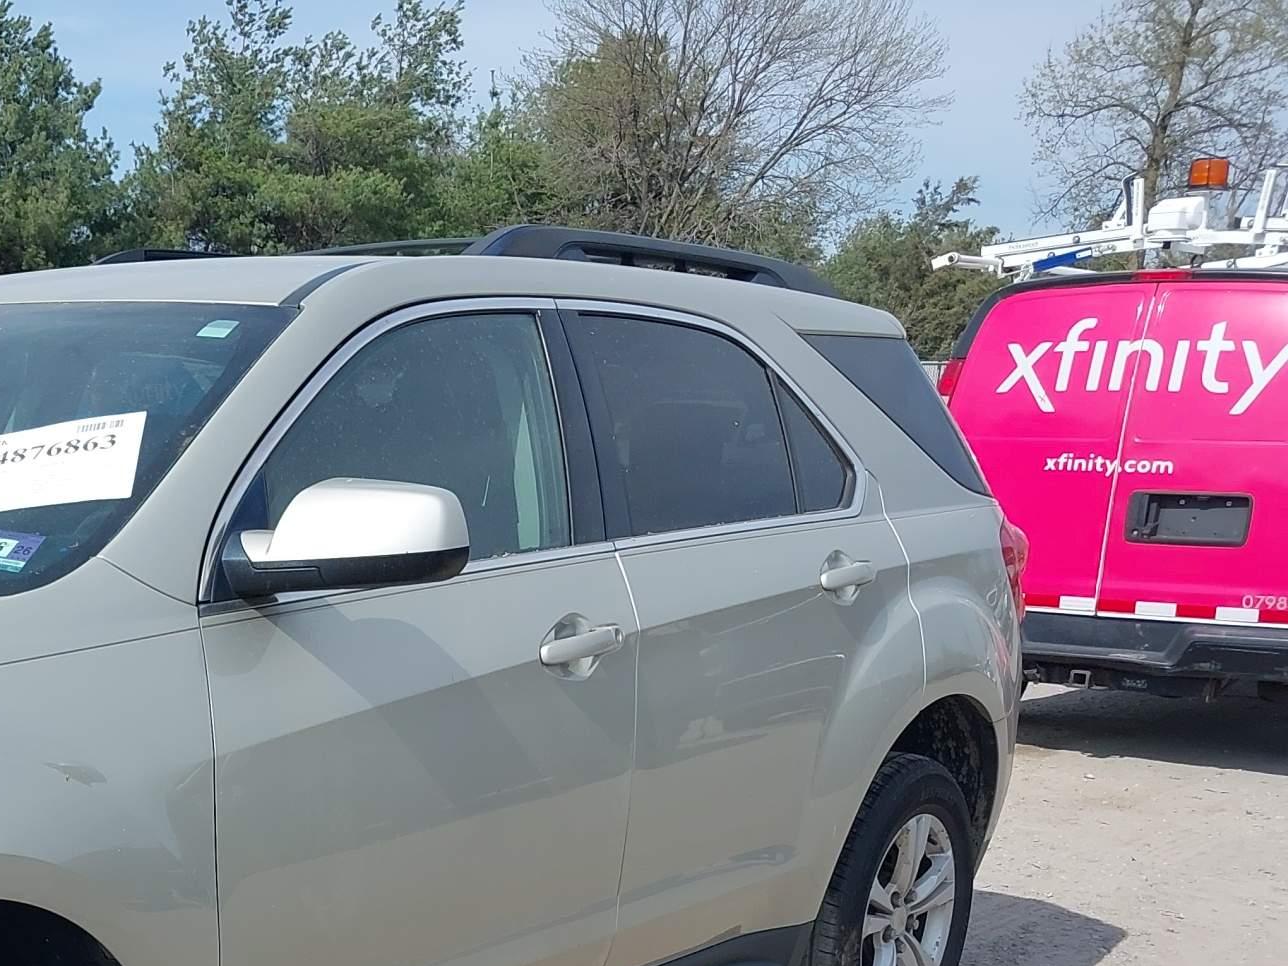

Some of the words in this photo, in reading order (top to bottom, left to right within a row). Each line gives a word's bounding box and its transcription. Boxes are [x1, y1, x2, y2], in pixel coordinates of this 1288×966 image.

[996, 317, 1288, 415] xfinity
[1043, 452, 1174, 477] xfinity.com
[14, 545, 33, 556] 26
[1242, 594, 1288, 611] 0798
